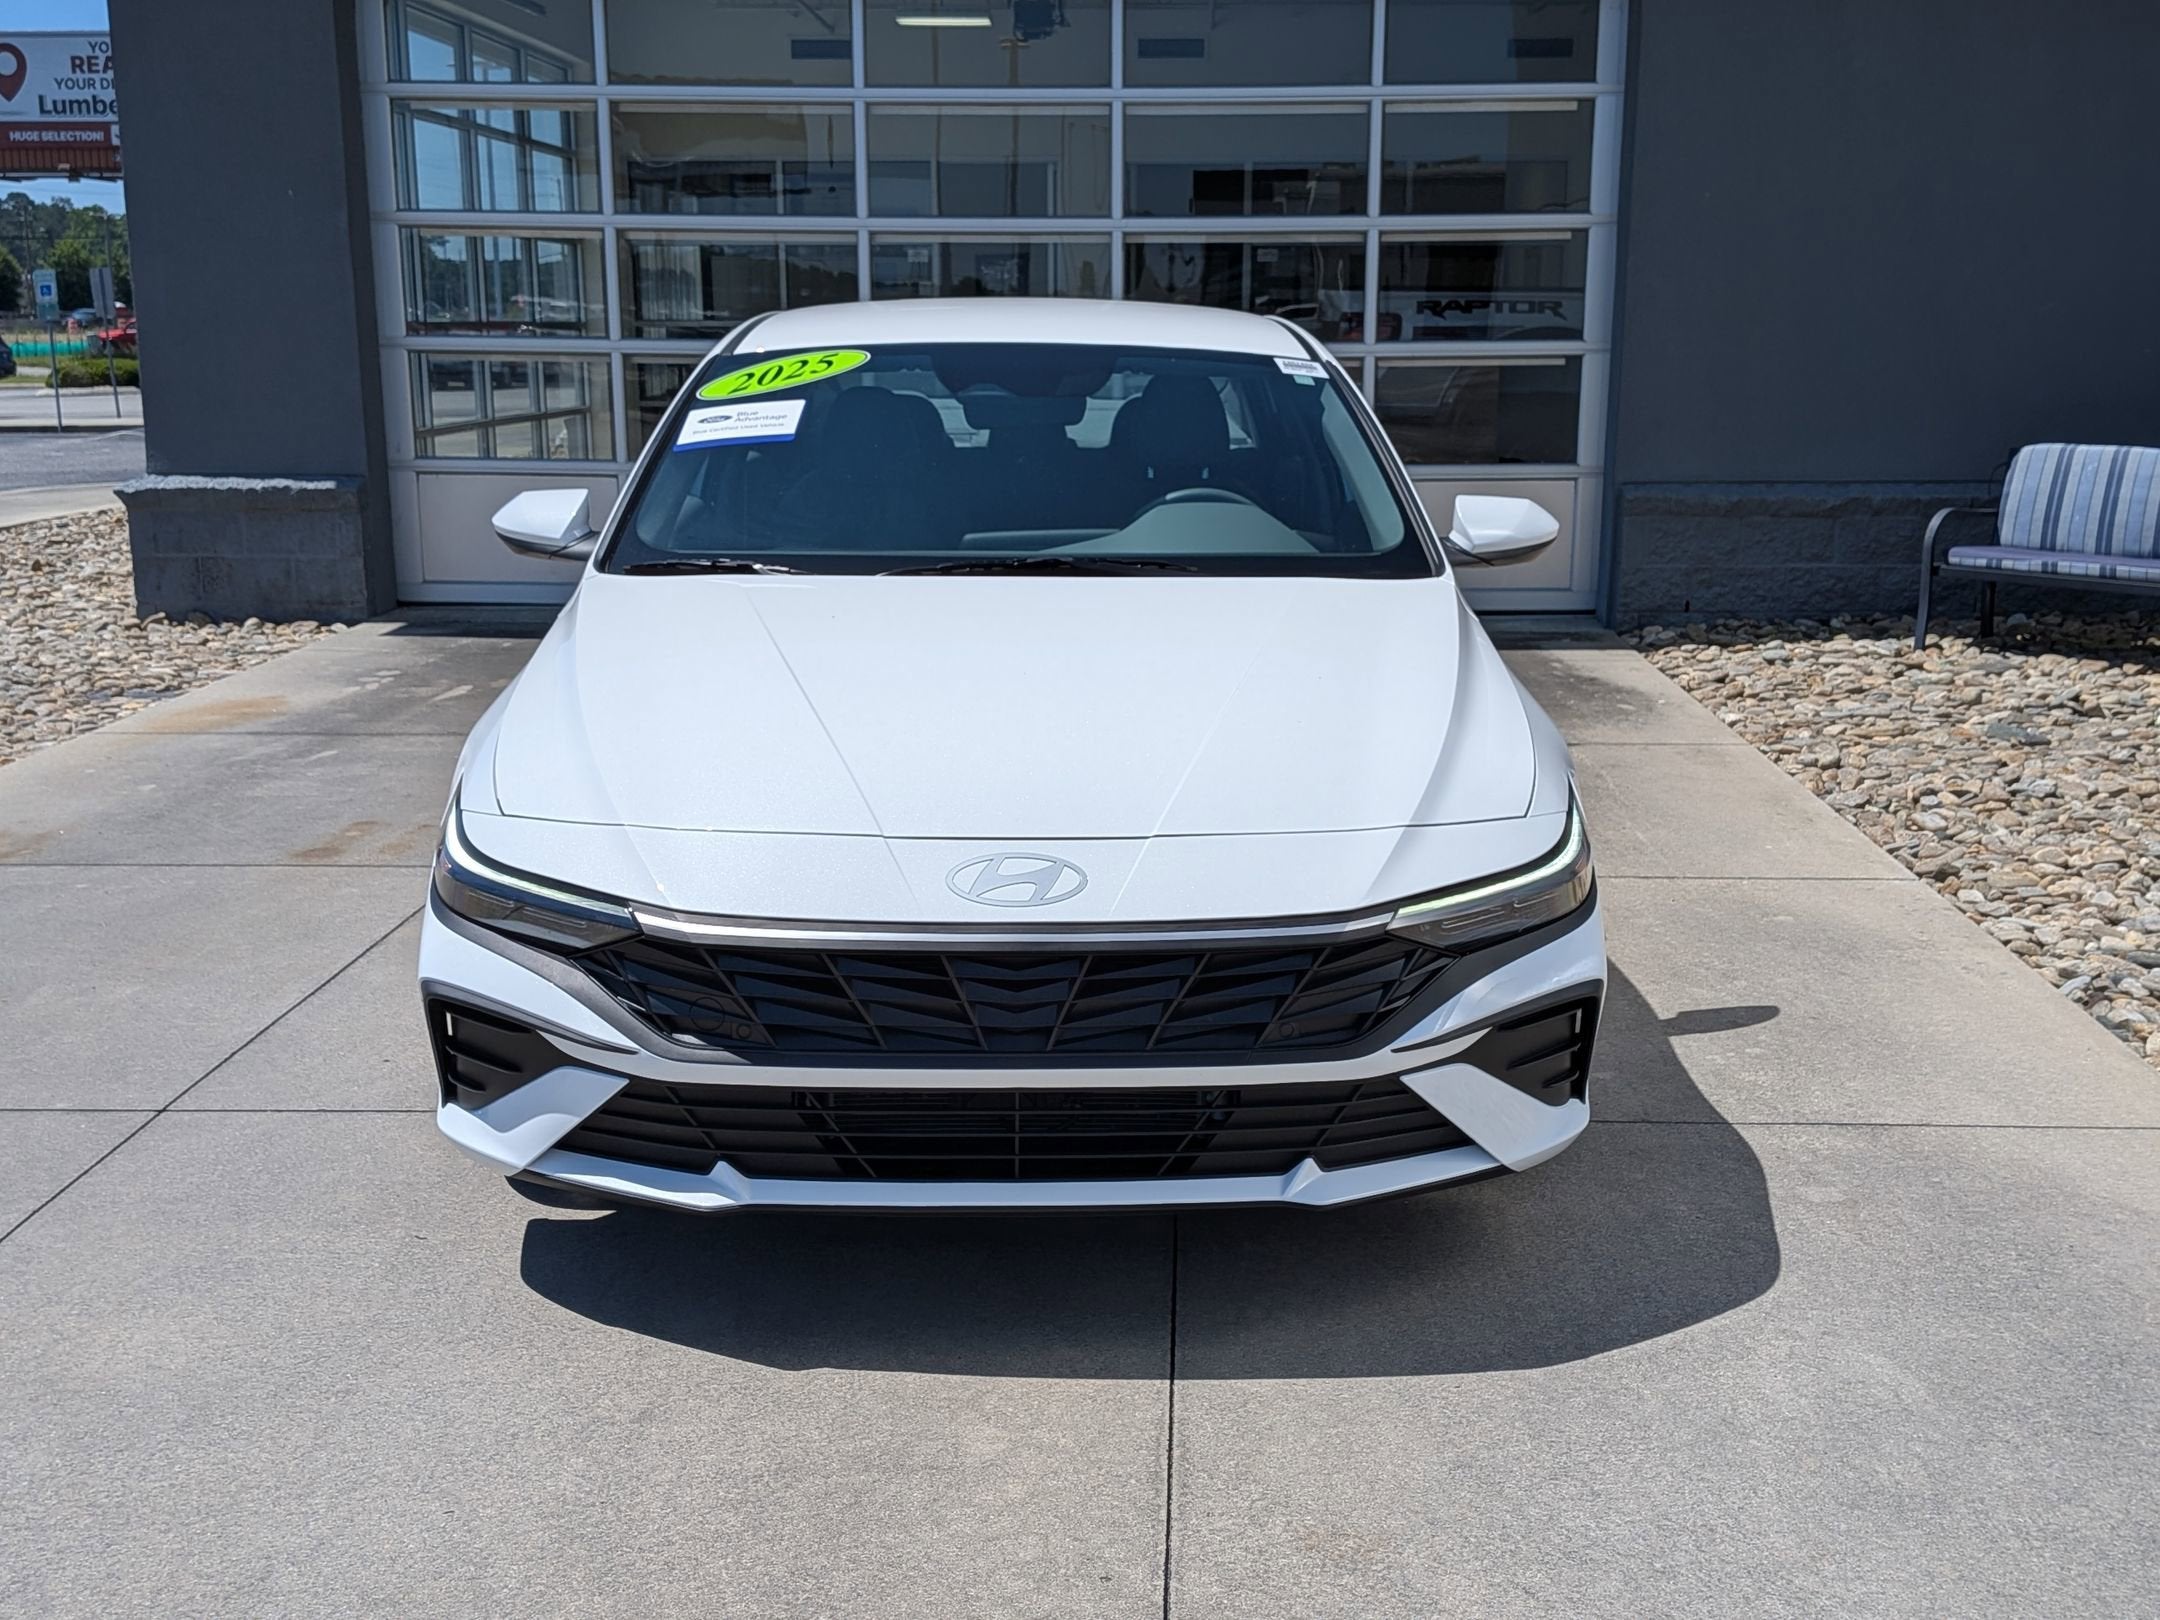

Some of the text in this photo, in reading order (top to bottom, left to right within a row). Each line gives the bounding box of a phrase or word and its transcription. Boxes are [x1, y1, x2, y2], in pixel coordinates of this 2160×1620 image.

[88, 41, 110, 54] YO
[71, 56, 114, 74] REA
[55, 78, 115, 90] YOUR D
[38, 94, 118, 115] Lumbe
[9, 131, 105, 142] HUGE SELECTION!
[1416, 300, 1568, 321] RAPTOR
[726, 353, 839, 395] 2025
